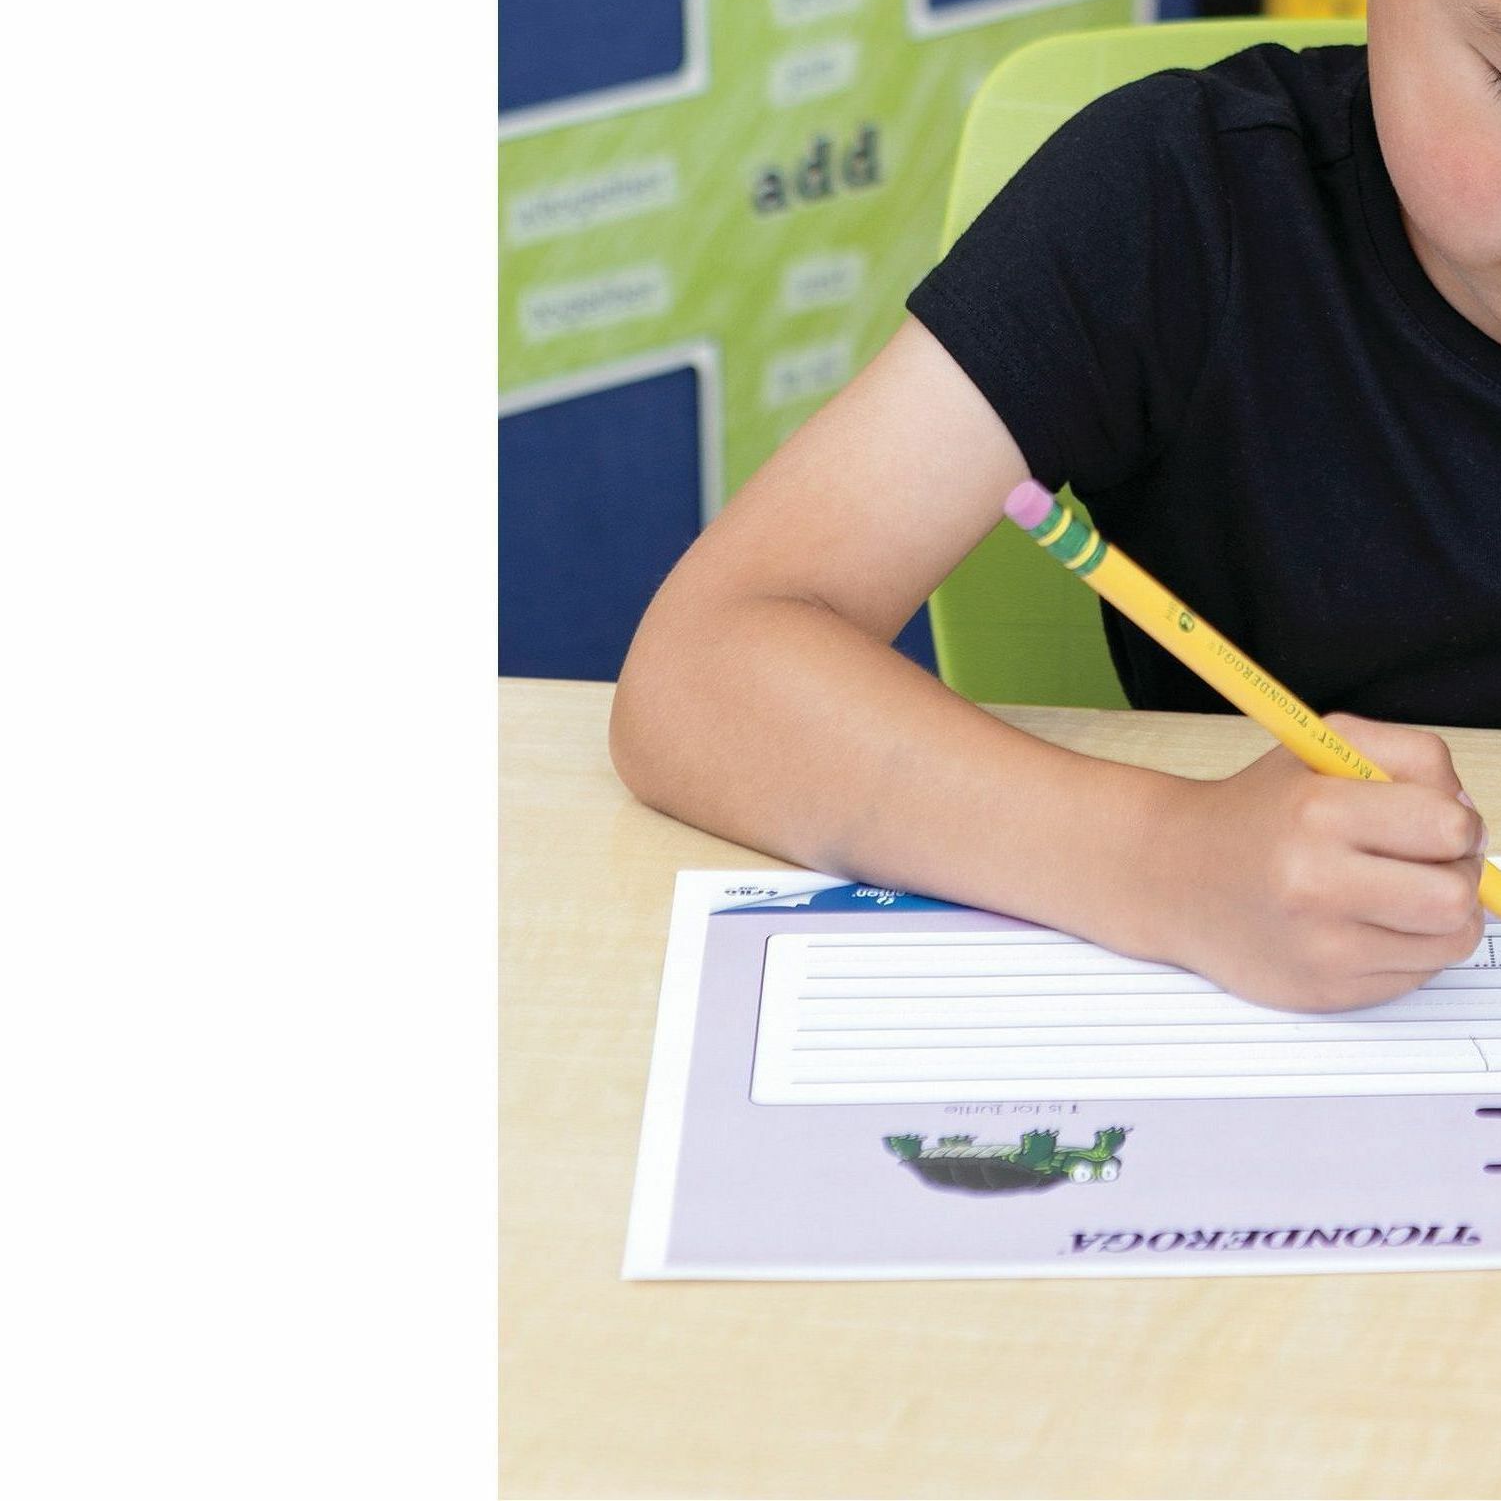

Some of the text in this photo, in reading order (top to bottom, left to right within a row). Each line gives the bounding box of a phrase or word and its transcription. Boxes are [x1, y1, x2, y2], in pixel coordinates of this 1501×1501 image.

[753, 121, 884, 215] add
[1216, 643, 1309, 729] TICONDEROGA
[1068, 1224, 1483, 1255] TICONDEROGA
